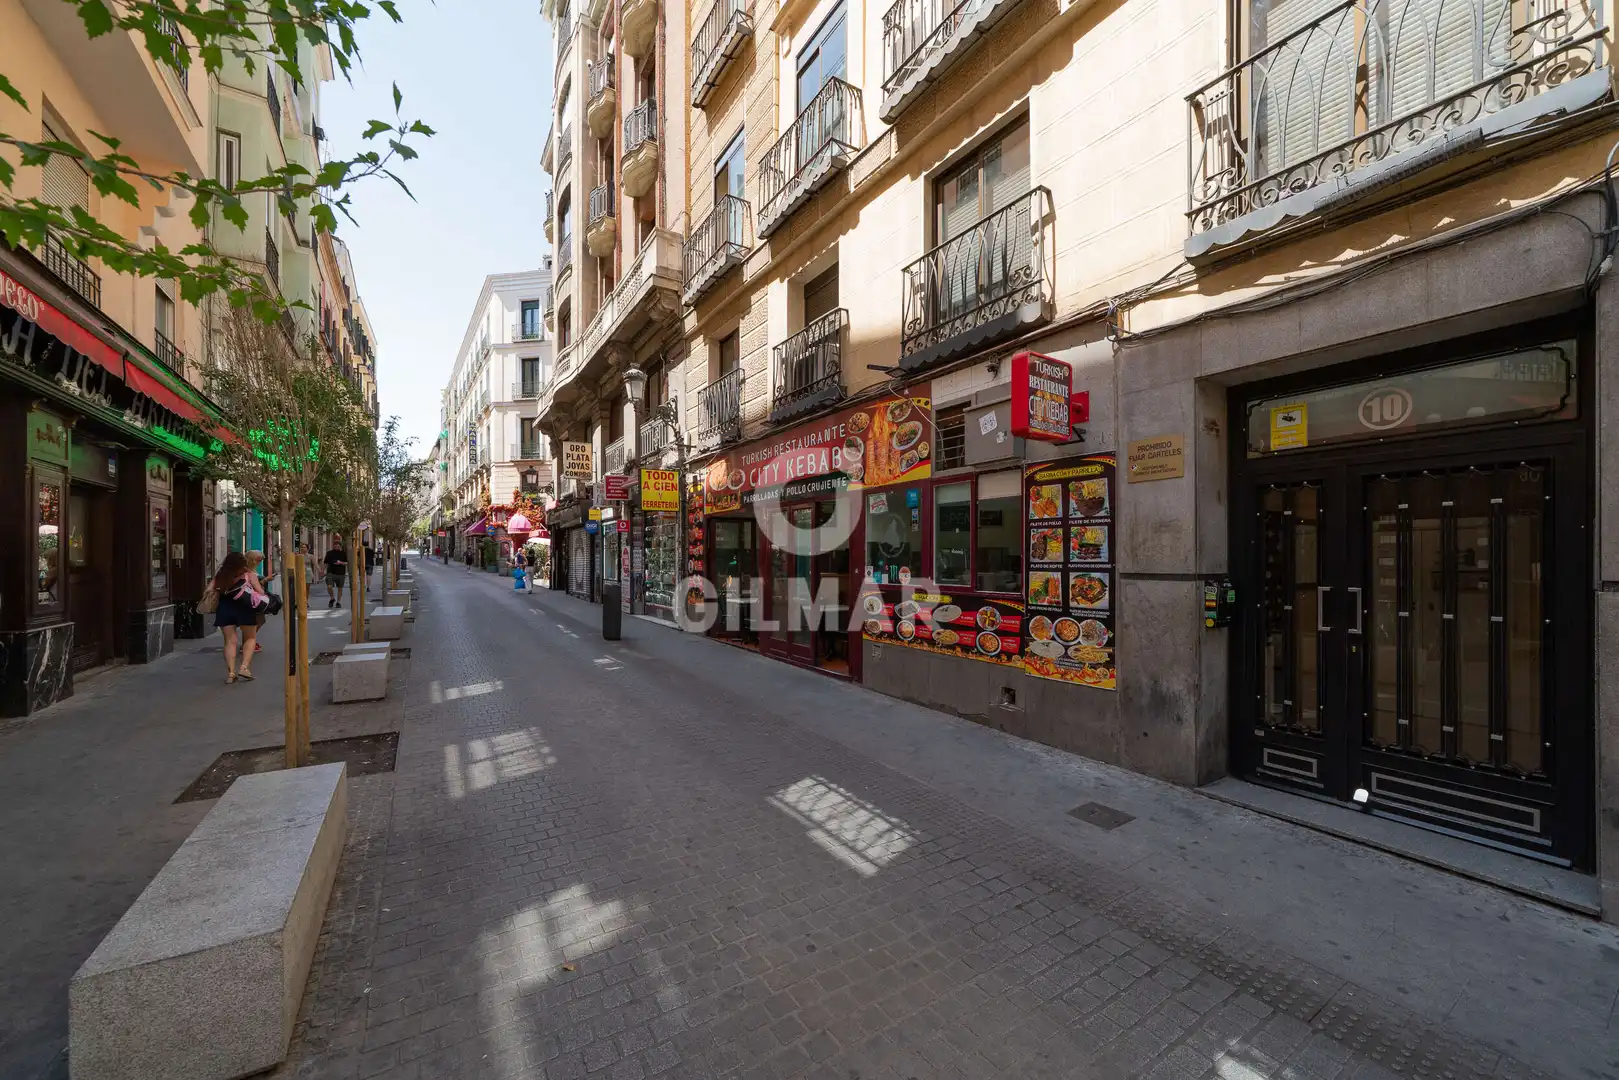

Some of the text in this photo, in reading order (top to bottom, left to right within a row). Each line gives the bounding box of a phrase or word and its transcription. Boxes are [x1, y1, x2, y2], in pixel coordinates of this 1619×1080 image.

[1034, 360, 1064, 380] TURKISH
[1029, 375, 1069, 398] RESTAURANTE
[1029, 395, 1069, 423] CITY KEBAB
[1367, 394, 1403, 423] 10
[570, 444, 586, 453] ORO
[742, 423, 846, 467] TURKISH RESTAURANTE
[1137, 440, 1173, 452] PROHIBIDO
[566, 453, 590, 462] PLATA
[1147, 447, 1182, 460] CARTELES
[566, 462, 590, 471] JOYAS
[749, 446, 842, 487] CITY KEBAB
[565, 470, 591, 478] COMPRO
[646, 470, 675, 480] TODO
[643, 481, 651, 490] A
[743, 476, 847, 503] PARRILLADAS Y POLLO CRUJIENTE
